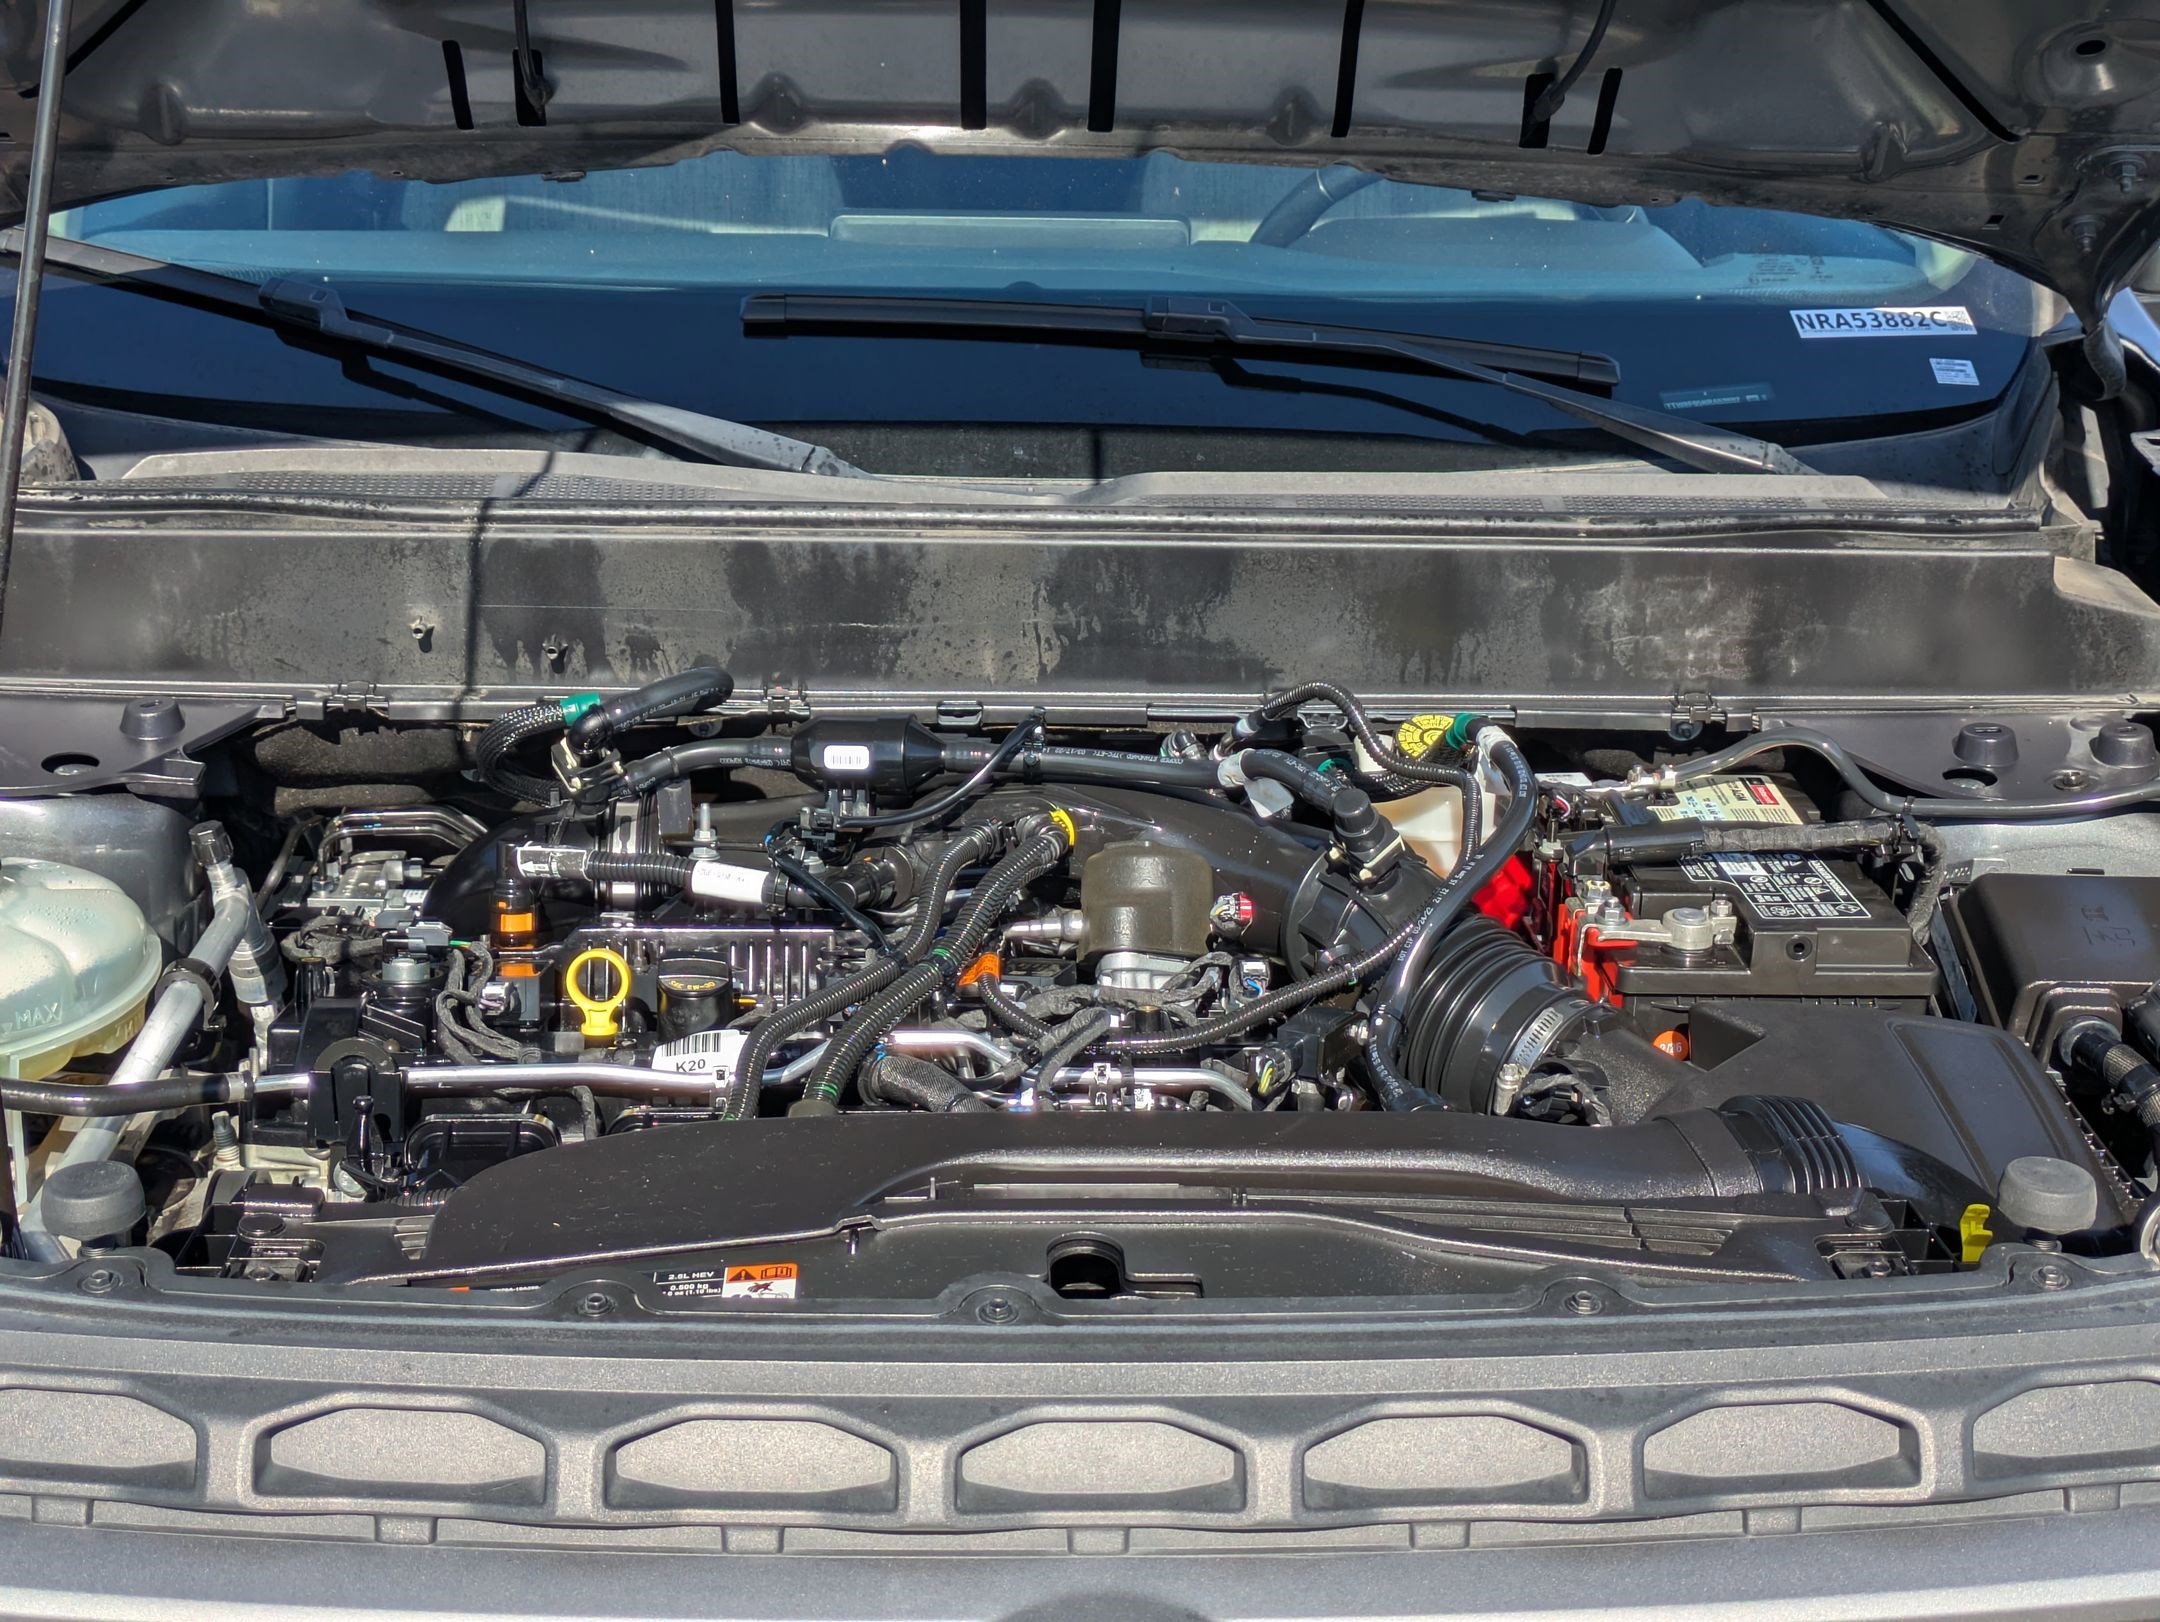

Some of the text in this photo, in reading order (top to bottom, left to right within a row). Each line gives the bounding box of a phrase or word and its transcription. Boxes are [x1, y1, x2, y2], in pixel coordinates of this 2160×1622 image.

[1795, 311, 1947, 330] NRA53882C
[15, 1002, 58, 1030] MAX
[676, 1058, 706, 1073] K20
[692, 1271, 714, 1279] HEV
